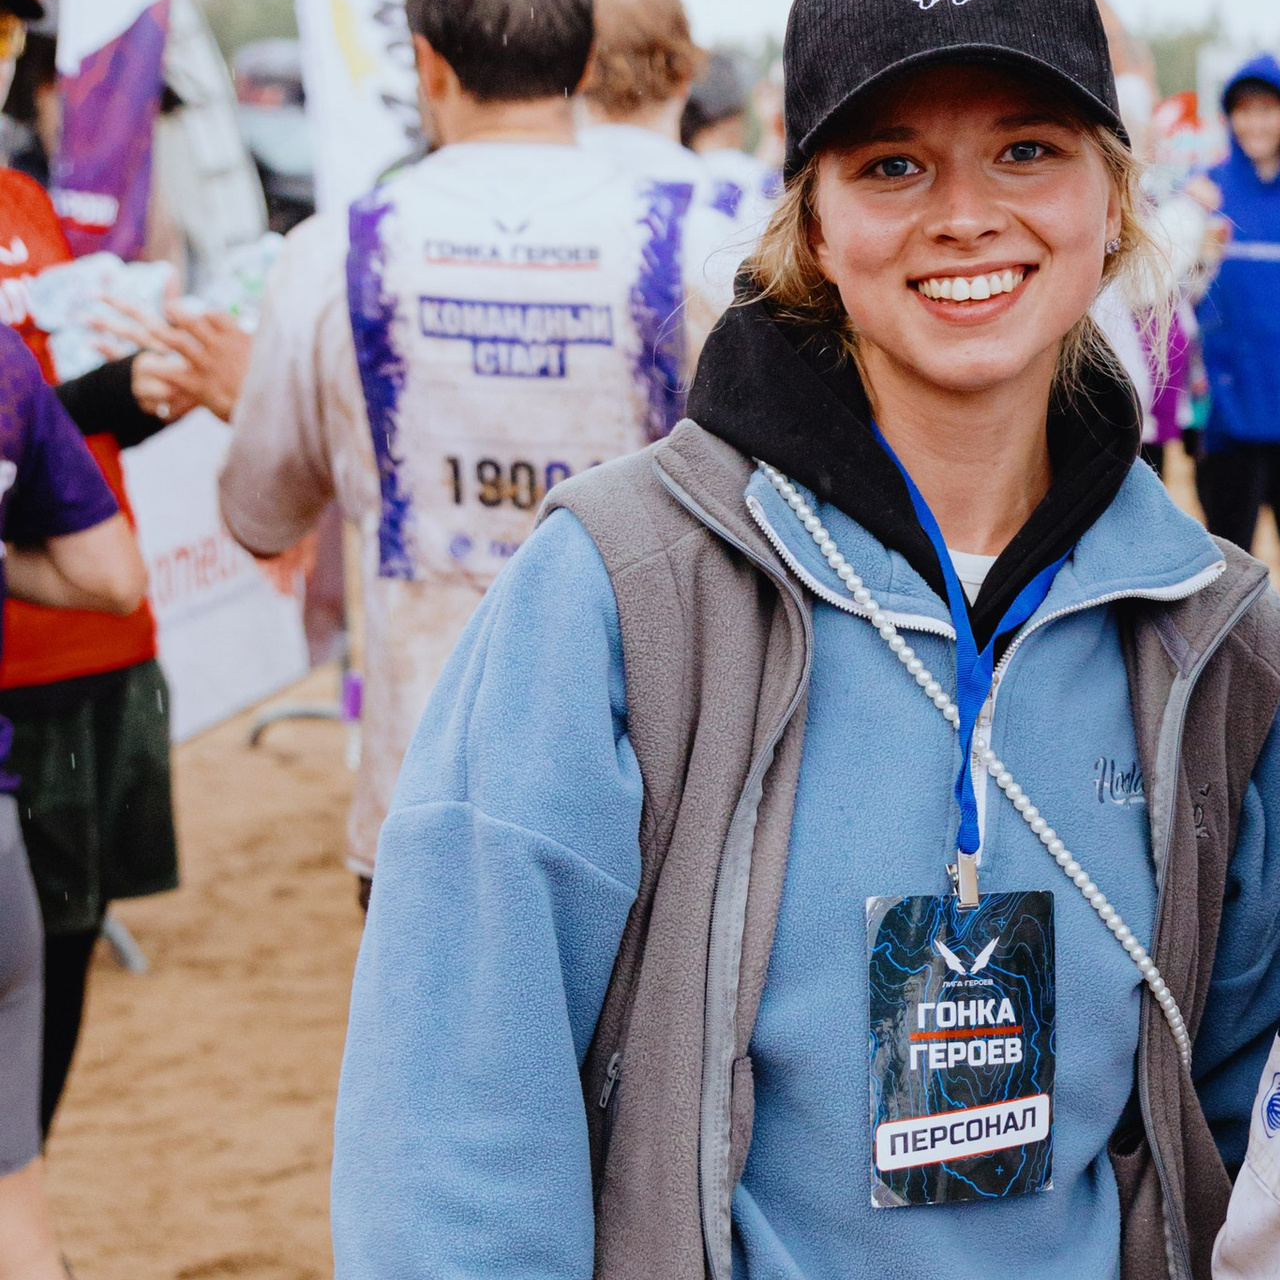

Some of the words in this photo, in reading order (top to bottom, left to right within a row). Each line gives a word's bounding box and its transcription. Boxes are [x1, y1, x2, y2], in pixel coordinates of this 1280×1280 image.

[476, 342, 560, 375] СТАРТ
[941, 980, 963, 988] ЛИГА
[964, 978, 994, 987] ГЕРОЕВ
[917, 997, 1017, 1029] ГОНКА
[909, 1037, 1024, 1071] ГЕРОЕВ
[889, 1106, 1037, 1157] ПЕРСОНАЛ
